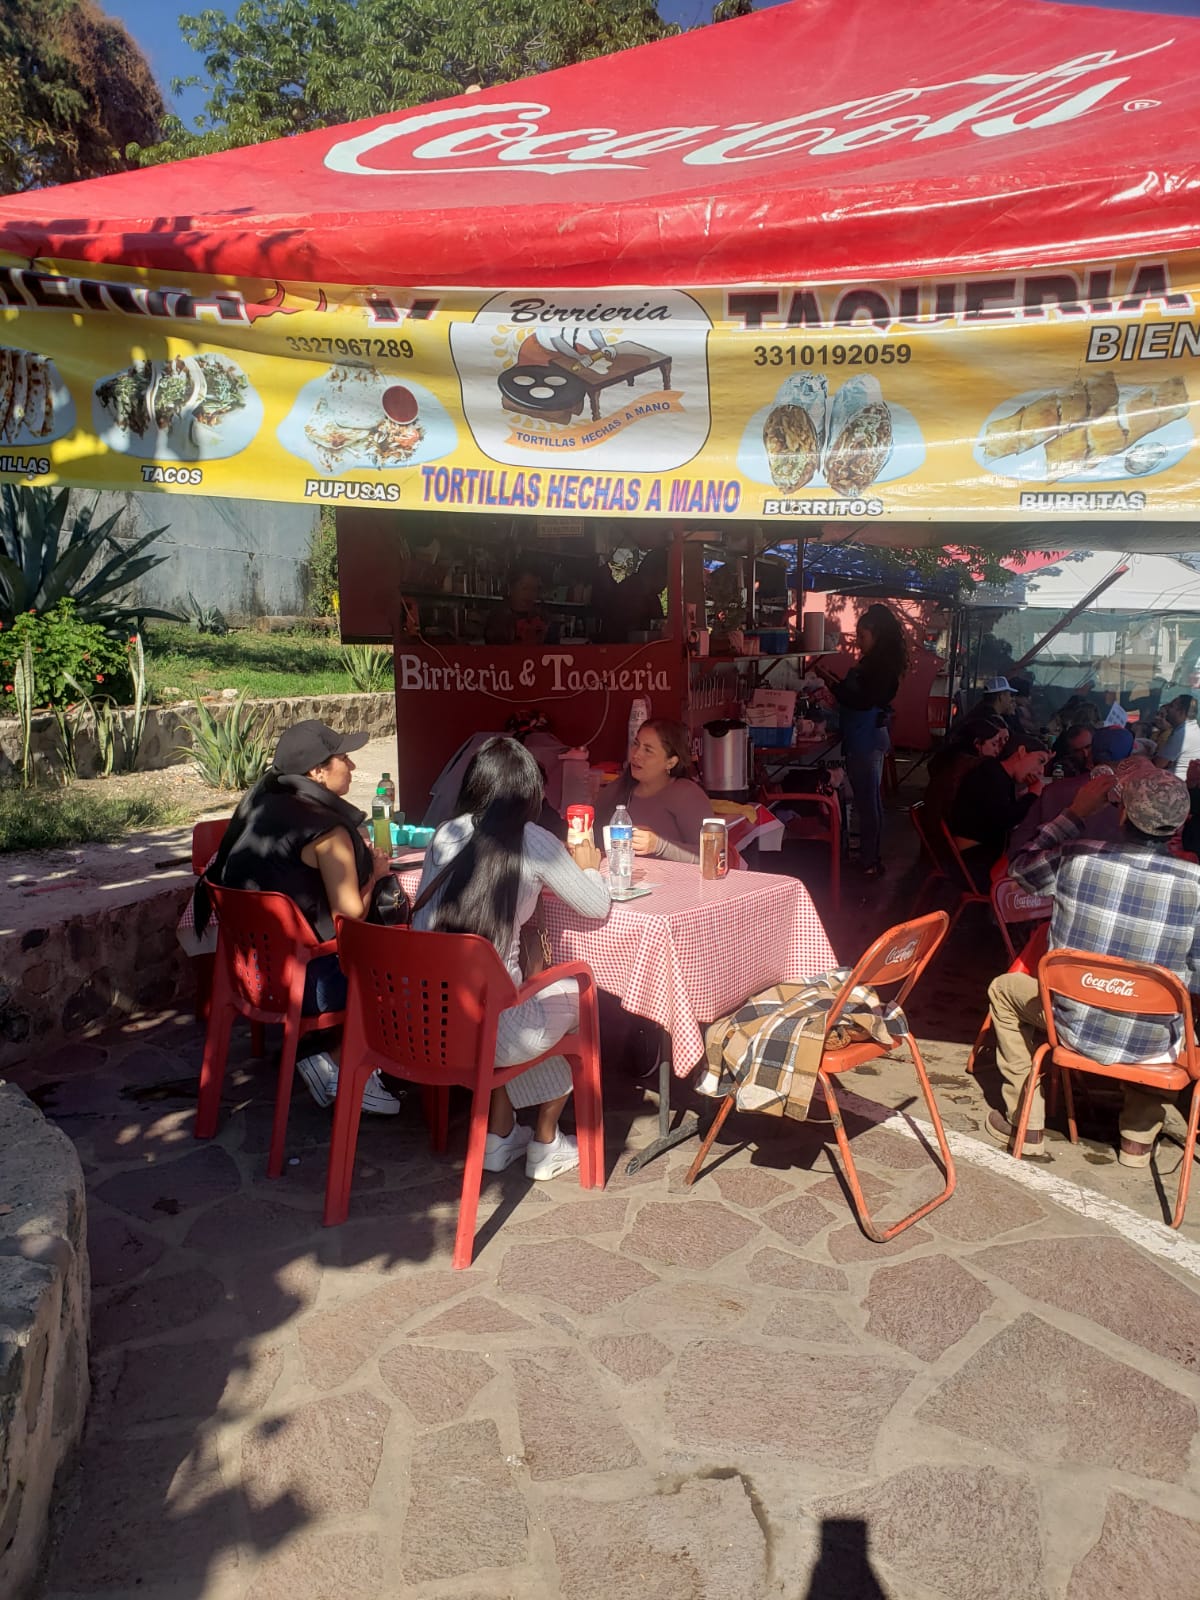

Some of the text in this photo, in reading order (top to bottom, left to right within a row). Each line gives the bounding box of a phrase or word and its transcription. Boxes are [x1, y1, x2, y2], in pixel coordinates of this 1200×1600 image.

[323, 38, 1175, 174] Coca-Cola
[726, 262, 1192, 333] TAQUERIA
[510, 298, 671, 323] Birrieria
[285, 336, 414, 359] 3327967289
[754, 343, 912, 366] 3310192059
[516, 402, 671, 448] TORTILLAS HECHAS A MANO
[0, 456, 51, 475] ILLAS
[141, 466, 202, 484] TACOS
[304, 479, 400, 501] PUPUSAS
[421, 466, 742, 514] TORTILLAS HECHAS A MANO
[1019, 491, 1147, 512] BURRITAS
[763, 499, 884, 516] BURRITOS
[400, 654, 515, 692] Birrieria
[519, 659, 536, 687] &
[1081, 972, 1137, 997] Coca-Cola
